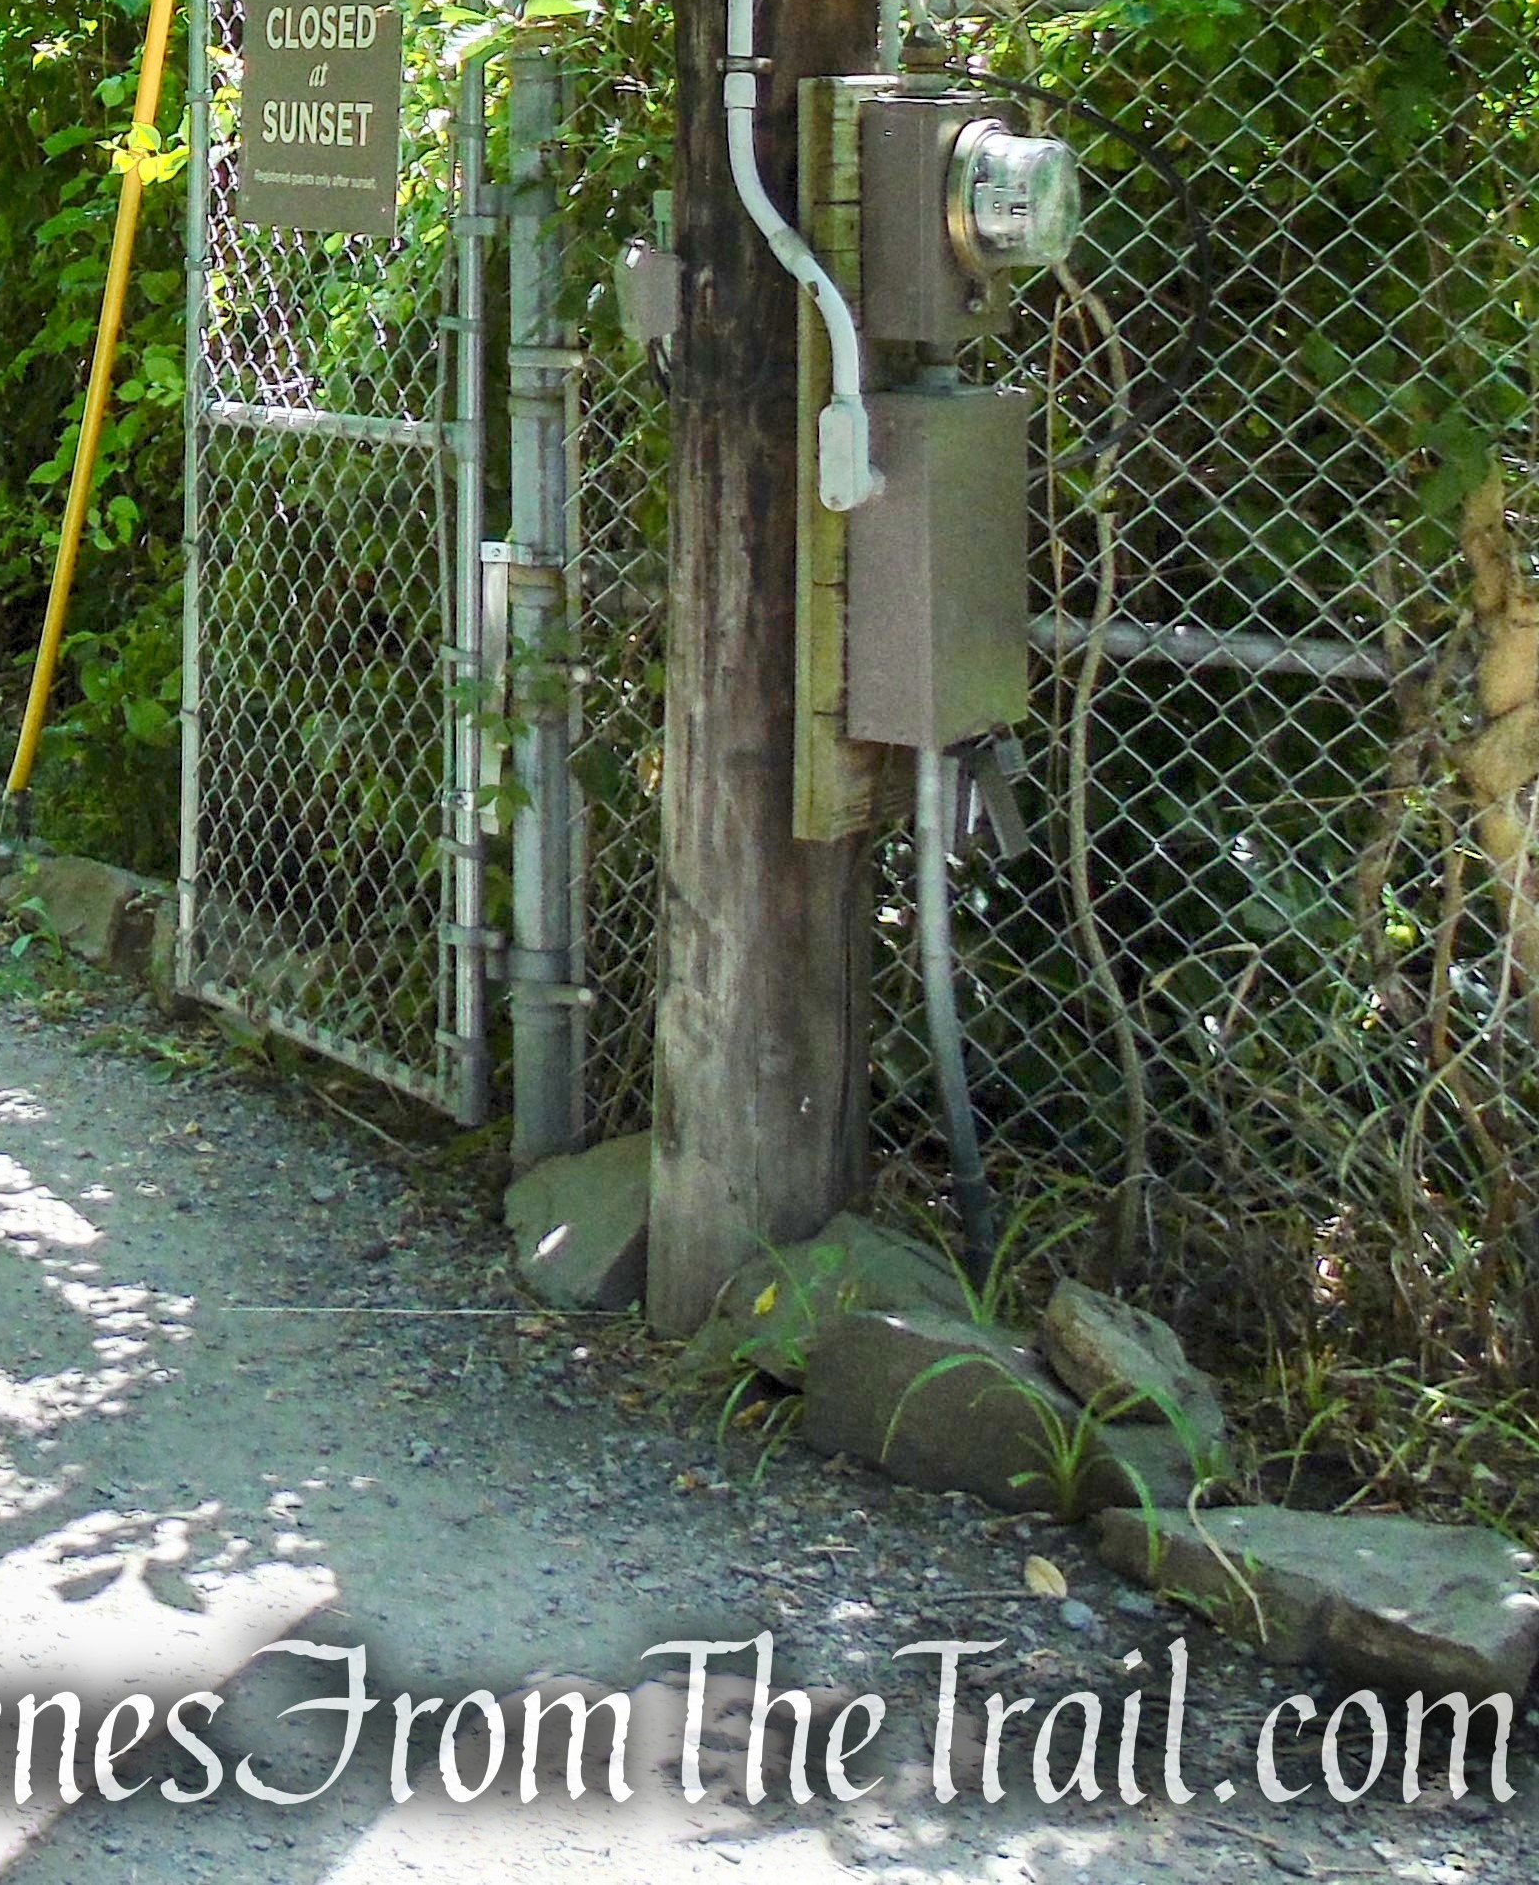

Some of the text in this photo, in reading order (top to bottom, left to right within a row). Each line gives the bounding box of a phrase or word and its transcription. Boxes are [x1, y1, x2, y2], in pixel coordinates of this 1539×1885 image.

[266, 4, 377, 49] CLOSED
[308, 62, 329, 87] at
[262, 100, 373, 147] SUNSET
